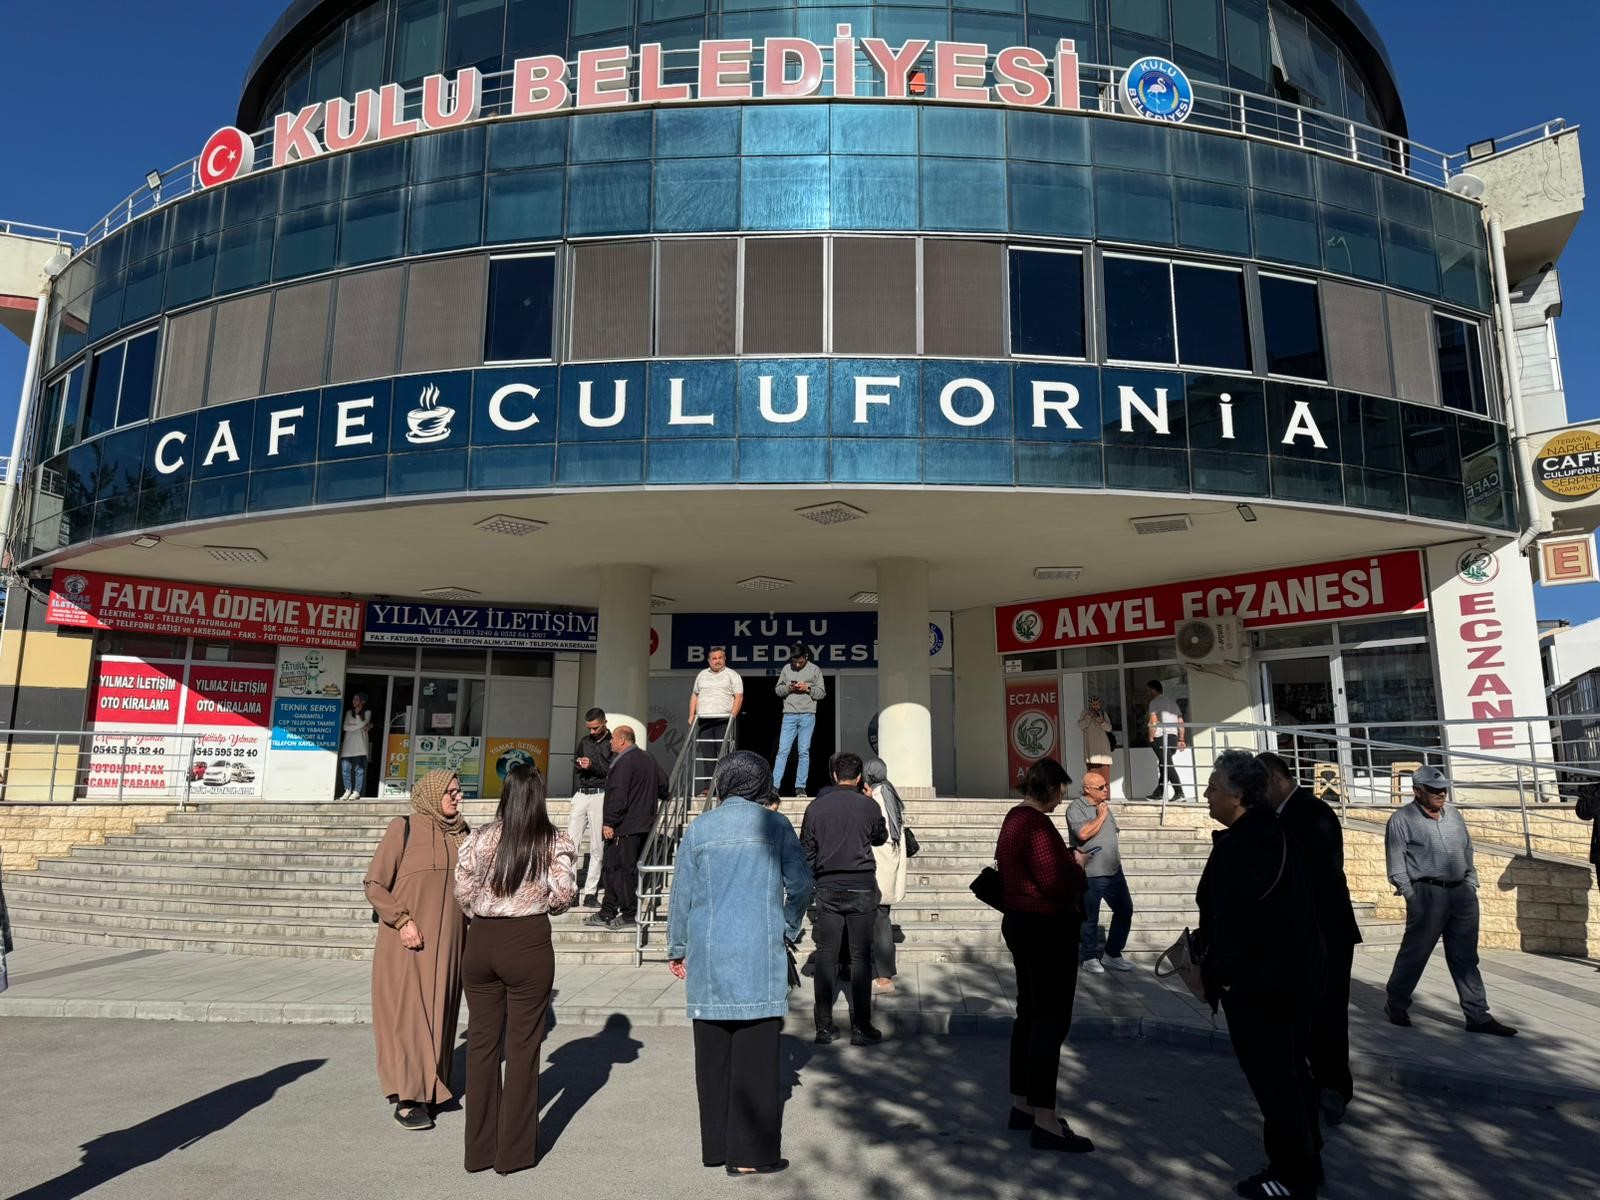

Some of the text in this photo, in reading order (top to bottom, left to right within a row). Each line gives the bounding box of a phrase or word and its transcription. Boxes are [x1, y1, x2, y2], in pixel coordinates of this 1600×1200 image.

[1139, 60, 1177, 77] KULU
[272, 23, 1081, 168] KULU BELEDİYESİ
[153, 396, 375, 474] CAFE
[1542, 452, 1600, 471] CAFE
[1552, 545, 1582, 575] E
[101, 581, 360, 630] FATURA ÖDEME YERİ
[1054, 596, 1166, 640] AKYEL
[1182, 559, 1385, 621] ECZANESİ
[99, 608, 136, 619] ELEKTRİK
[144, 613, 154, 621] SU
[162, 615, 194, 625] TELEFON
[196, 618, 241, 629] FATURALARI
[116, 619, 155, 630] TELEFONU
[373, 604, 597, 637] YILMAZ İLETİŞİM
[262, 624, 277, 632] SSK
[734, 619, 828, 637] KULU
[390, 635, 419, 643] FATURA
[420, 635, 446, 644] ÖDEME
[451, 637, 482, 645] TELEFON
[1459, 592, 1515, 750] ECZANE
[100, 674, 176, 693] YILMAZ İLETİŞİM
[196, 679, 228, 692] YILMAZ
[230, 678, 267, 695] İLETİŞİM
[100, 695, 169, 711] OTO KİRALAMA
[197, 699, 262, 714] OTO KİRALAMA
[1009, 692, 1057, 706] ECZANE
[92, 745, 118, 754] 0545
[138, 746, 151, 755] 32
[152, 747, 165, 755] 40
[215, 748, 232, 757] 595
[233, 748, 245, 757] 32
[246, 749, 258, 757] 40
